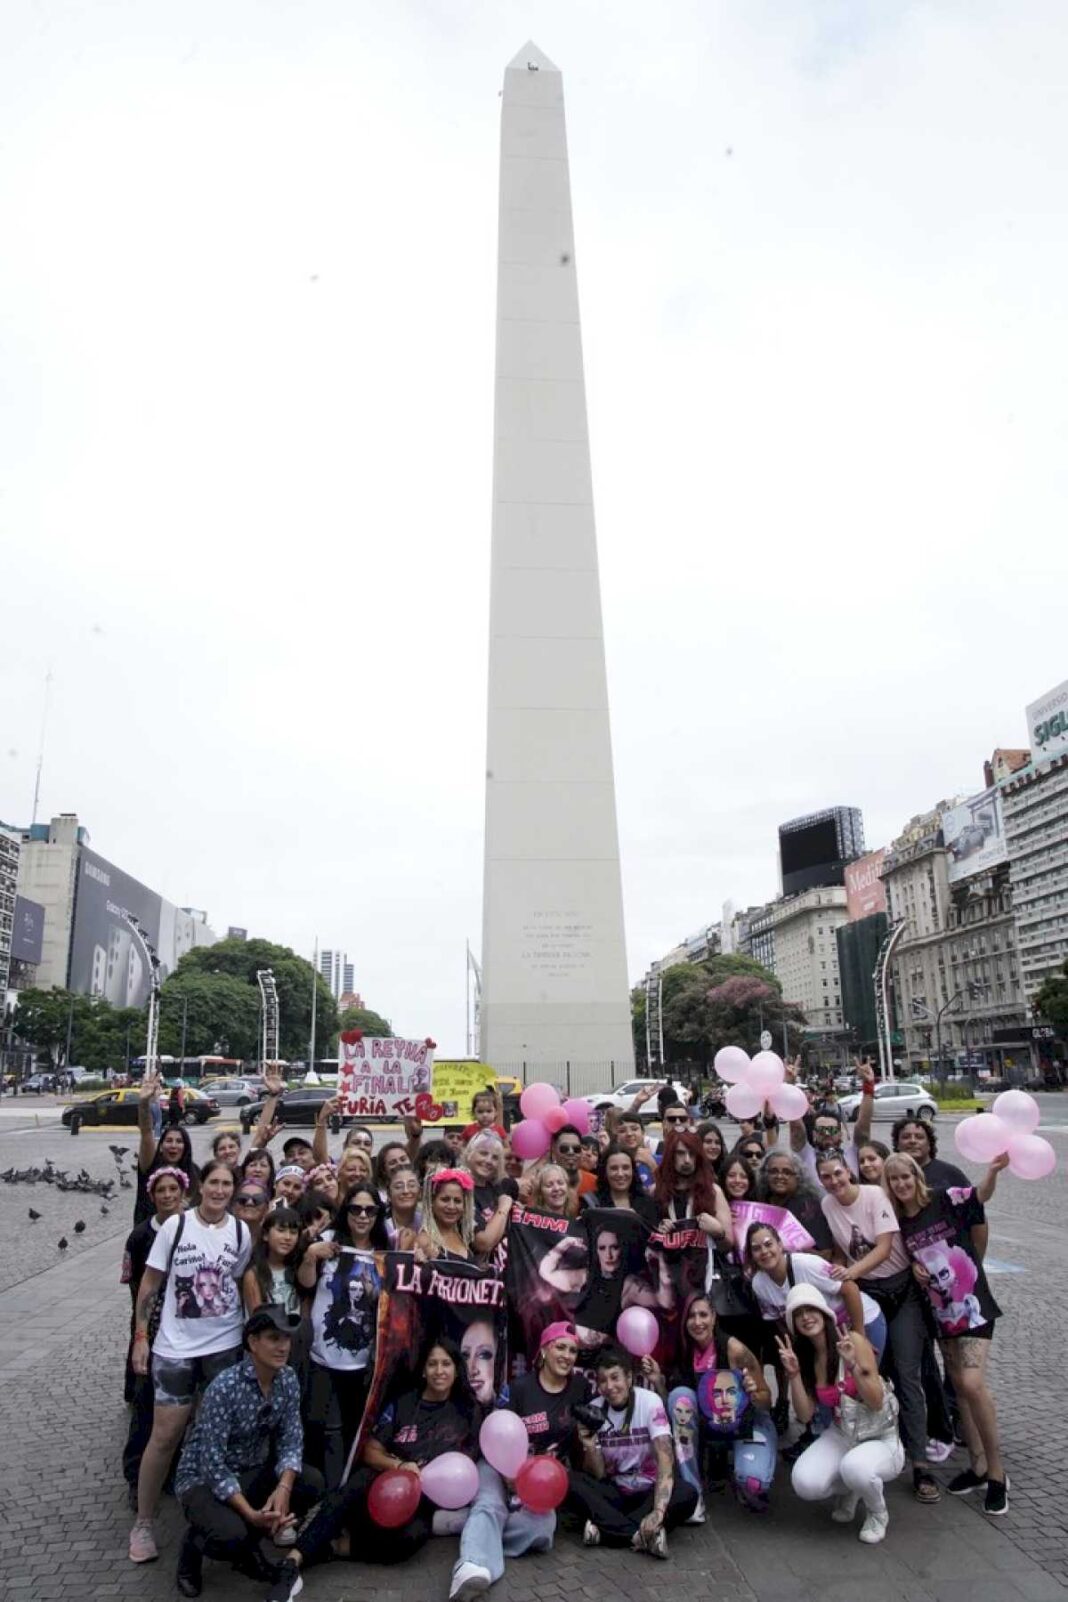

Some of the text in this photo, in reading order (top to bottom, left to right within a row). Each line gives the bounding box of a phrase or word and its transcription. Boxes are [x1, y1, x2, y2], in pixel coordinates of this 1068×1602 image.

[1033, 710, 1068, 747] SIGL
[343, 1039, 429, 1064] LA REYNA
[360, 1060, 402, 1075] A LA
[392, 1097, 415, 1116] TE
[396, 1263, 422, 1295] LA
